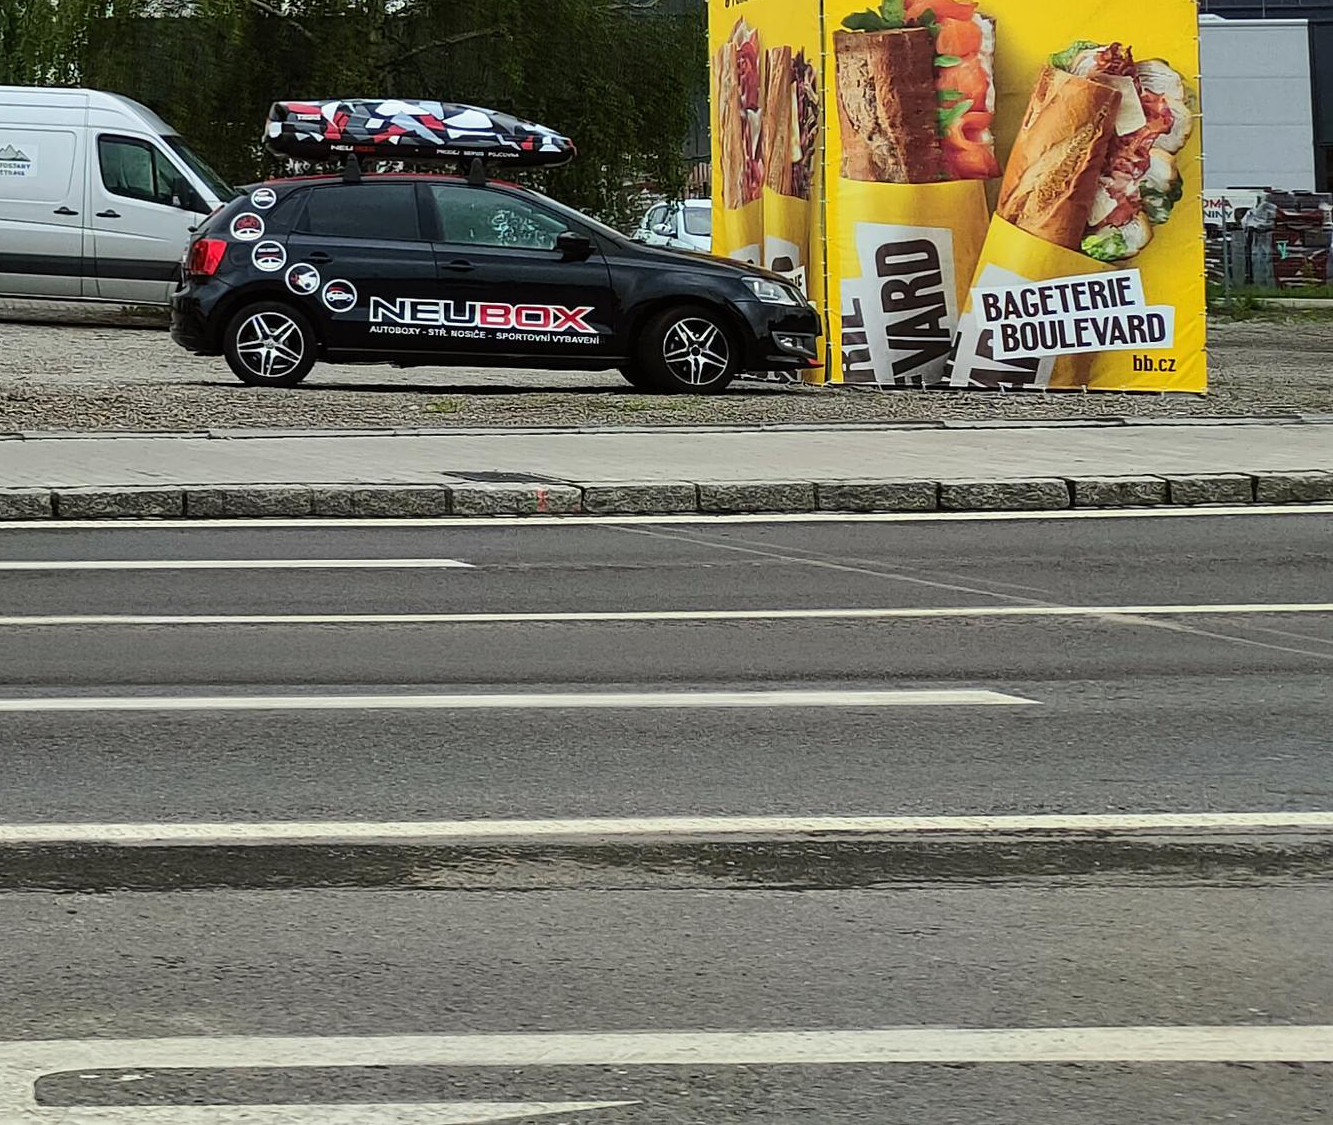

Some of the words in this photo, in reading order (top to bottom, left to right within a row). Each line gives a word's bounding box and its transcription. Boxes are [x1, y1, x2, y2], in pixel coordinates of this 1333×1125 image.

[369, 296, 599, 333] NEUBOX
[982, 276, 1135, 323] BAGETERIE
[369, 326, 421, 335] AUTOBOXY
[451, 329, 486, 339] NOSIČE
[496, 332, 551, 342] SPORTOVNÍ
[552, 335, 600, 345] VYBAVENÍ
[1001, 312, 1166, 353] BOULEVARD
[1132, 354, 1177, 373] bb.cz
